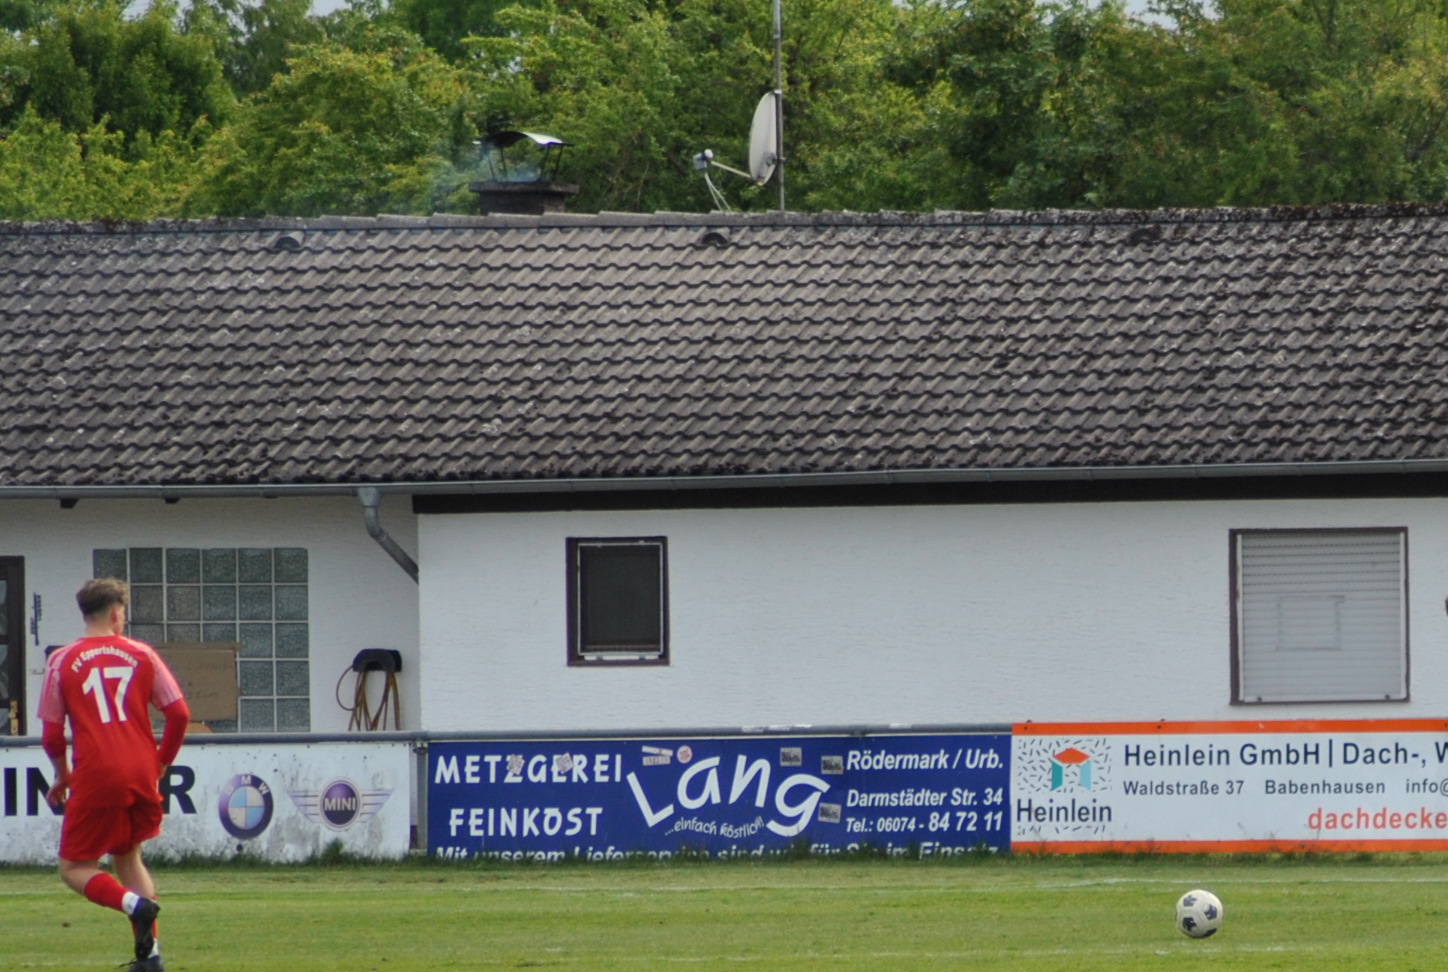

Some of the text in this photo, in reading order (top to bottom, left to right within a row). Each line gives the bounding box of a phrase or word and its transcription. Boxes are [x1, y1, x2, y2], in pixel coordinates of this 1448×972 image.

[80, 645, 138, 667] Eppertshausen
[82, 666, 134, 724] 17
[846, 749, 950, 770] Rödermark
[965, 748, 1004, 769] Urb.
[1124, 743, 1231, 767] Heinlein
[1239, 741, 1320, 766] GmbH
[1342, 741, 1427, 769] Dach-,
[434, 753, 622, 784] METZGEREI
[225, 774, 269, 797] BMW
[626, 754, 831, 838] Lang
[1123, 779, 1245, 796] Waldstraße 37
[1265, 779, 1386, 795] Babenhausen
[324, 797, 356, 811] MINI
[846, 787, 1004, 807] Darmstädter Str. 34
[1016, 798, 1113, 822] Heinlein
[449, 806, 603, 838] FEINKOST
[846, 817, 873, 833] Tel.:
[876, 817, 916, 832] 06074
[928, 811, 951, 832] 84
[955, 811, 978, 831] 72
[983, 811, 1004, 831] 11
